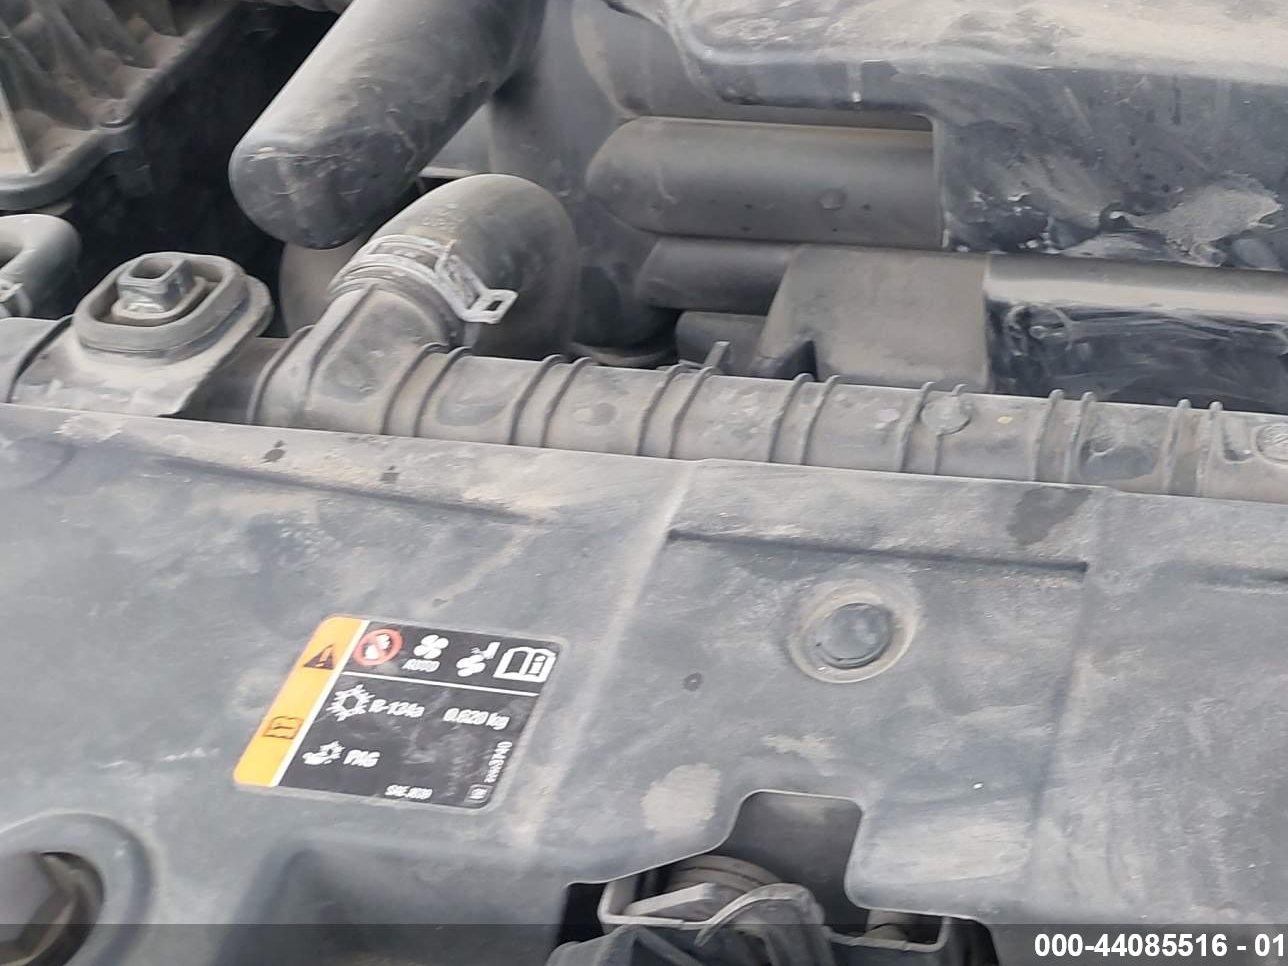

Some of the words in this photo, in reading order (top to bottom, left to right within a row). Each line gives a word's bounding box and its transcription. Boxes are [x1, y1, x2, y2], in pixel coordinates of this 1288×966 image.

[368, 698, 426, 718] R-134a
[485, 712, 511, 731] kg
[342, 749, 382, 768] PAG
